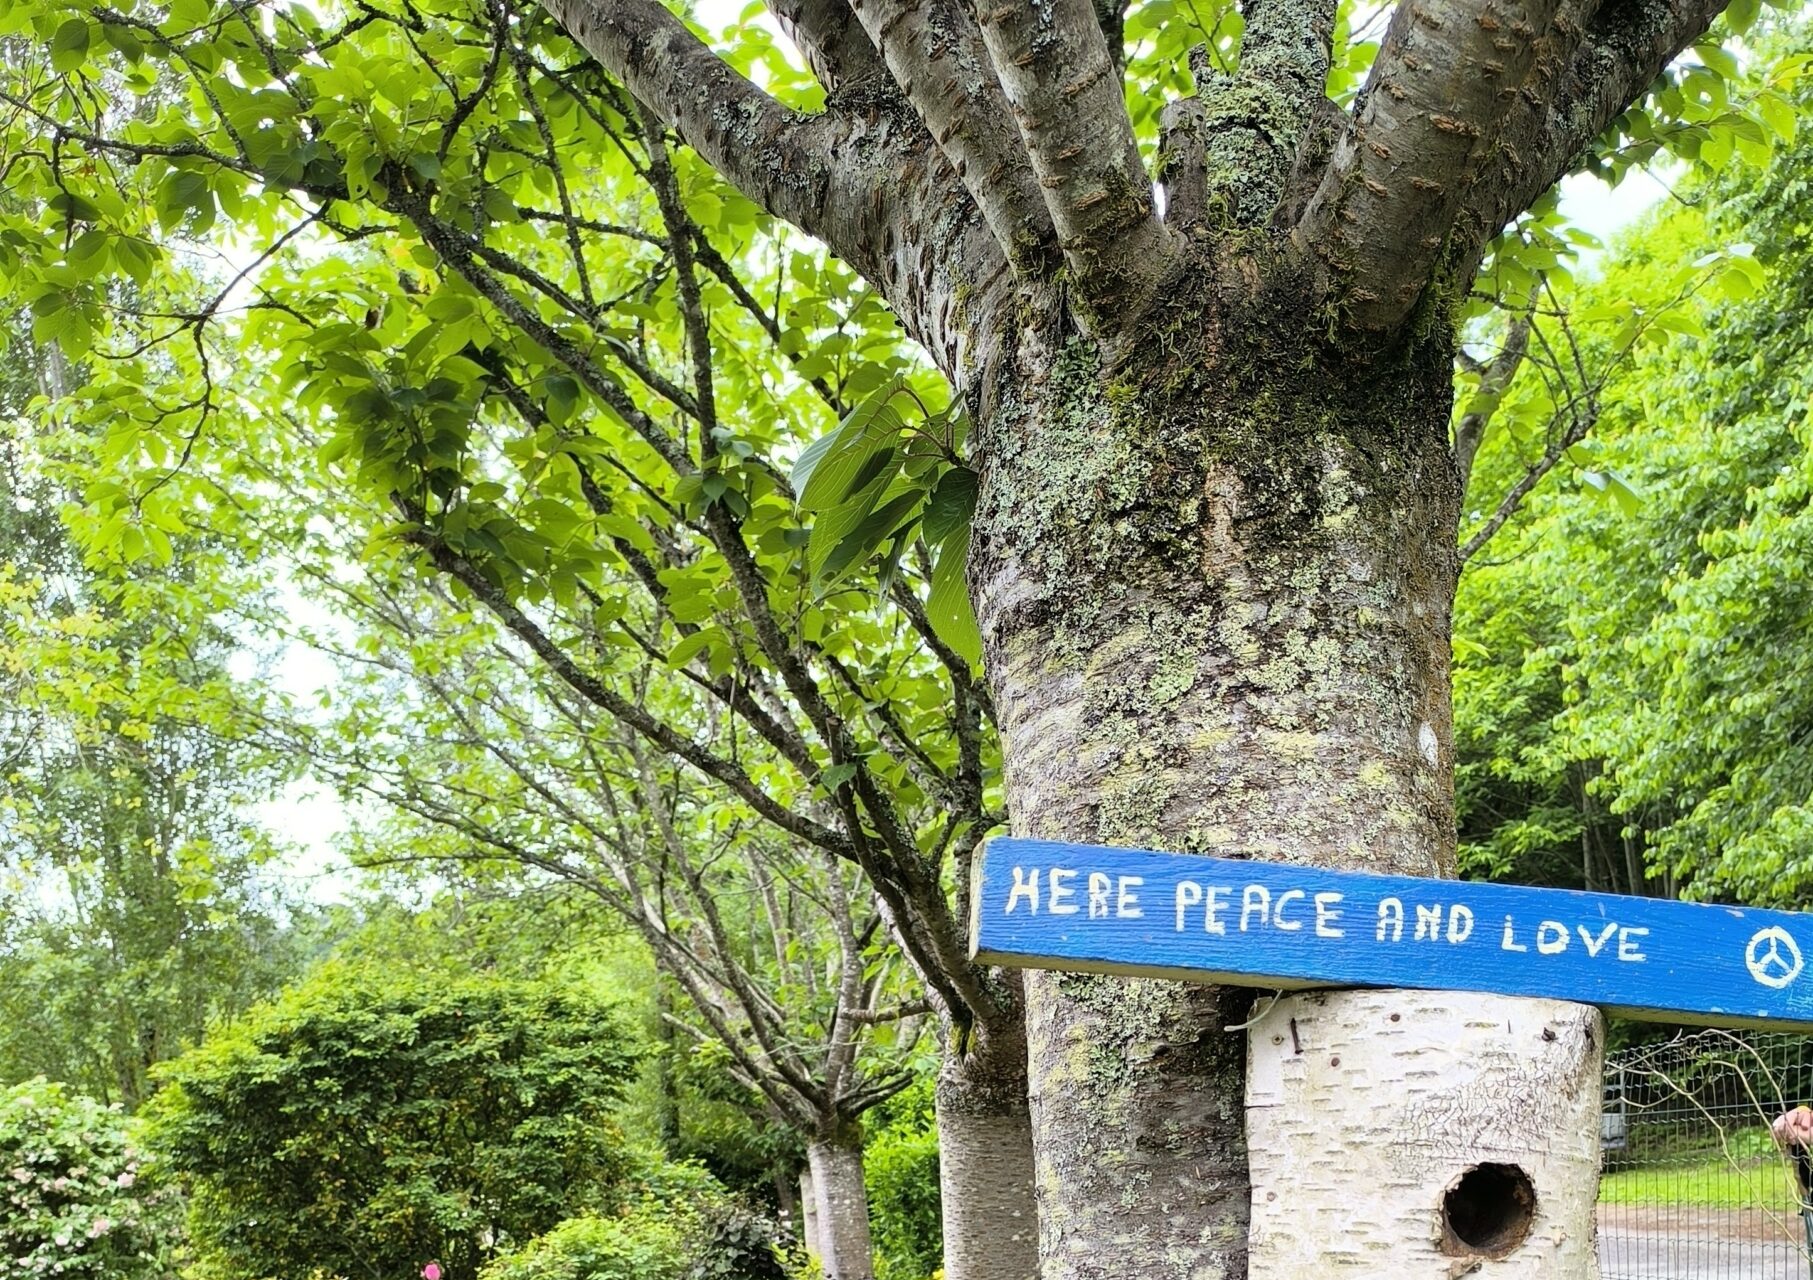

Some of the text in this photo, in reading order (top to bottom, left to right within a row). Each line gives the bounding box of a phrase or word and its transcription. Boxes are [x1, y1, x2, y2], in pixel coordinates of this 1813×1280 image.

[1004, 866, 1650, 963] HERE PEACE AND LOVE
